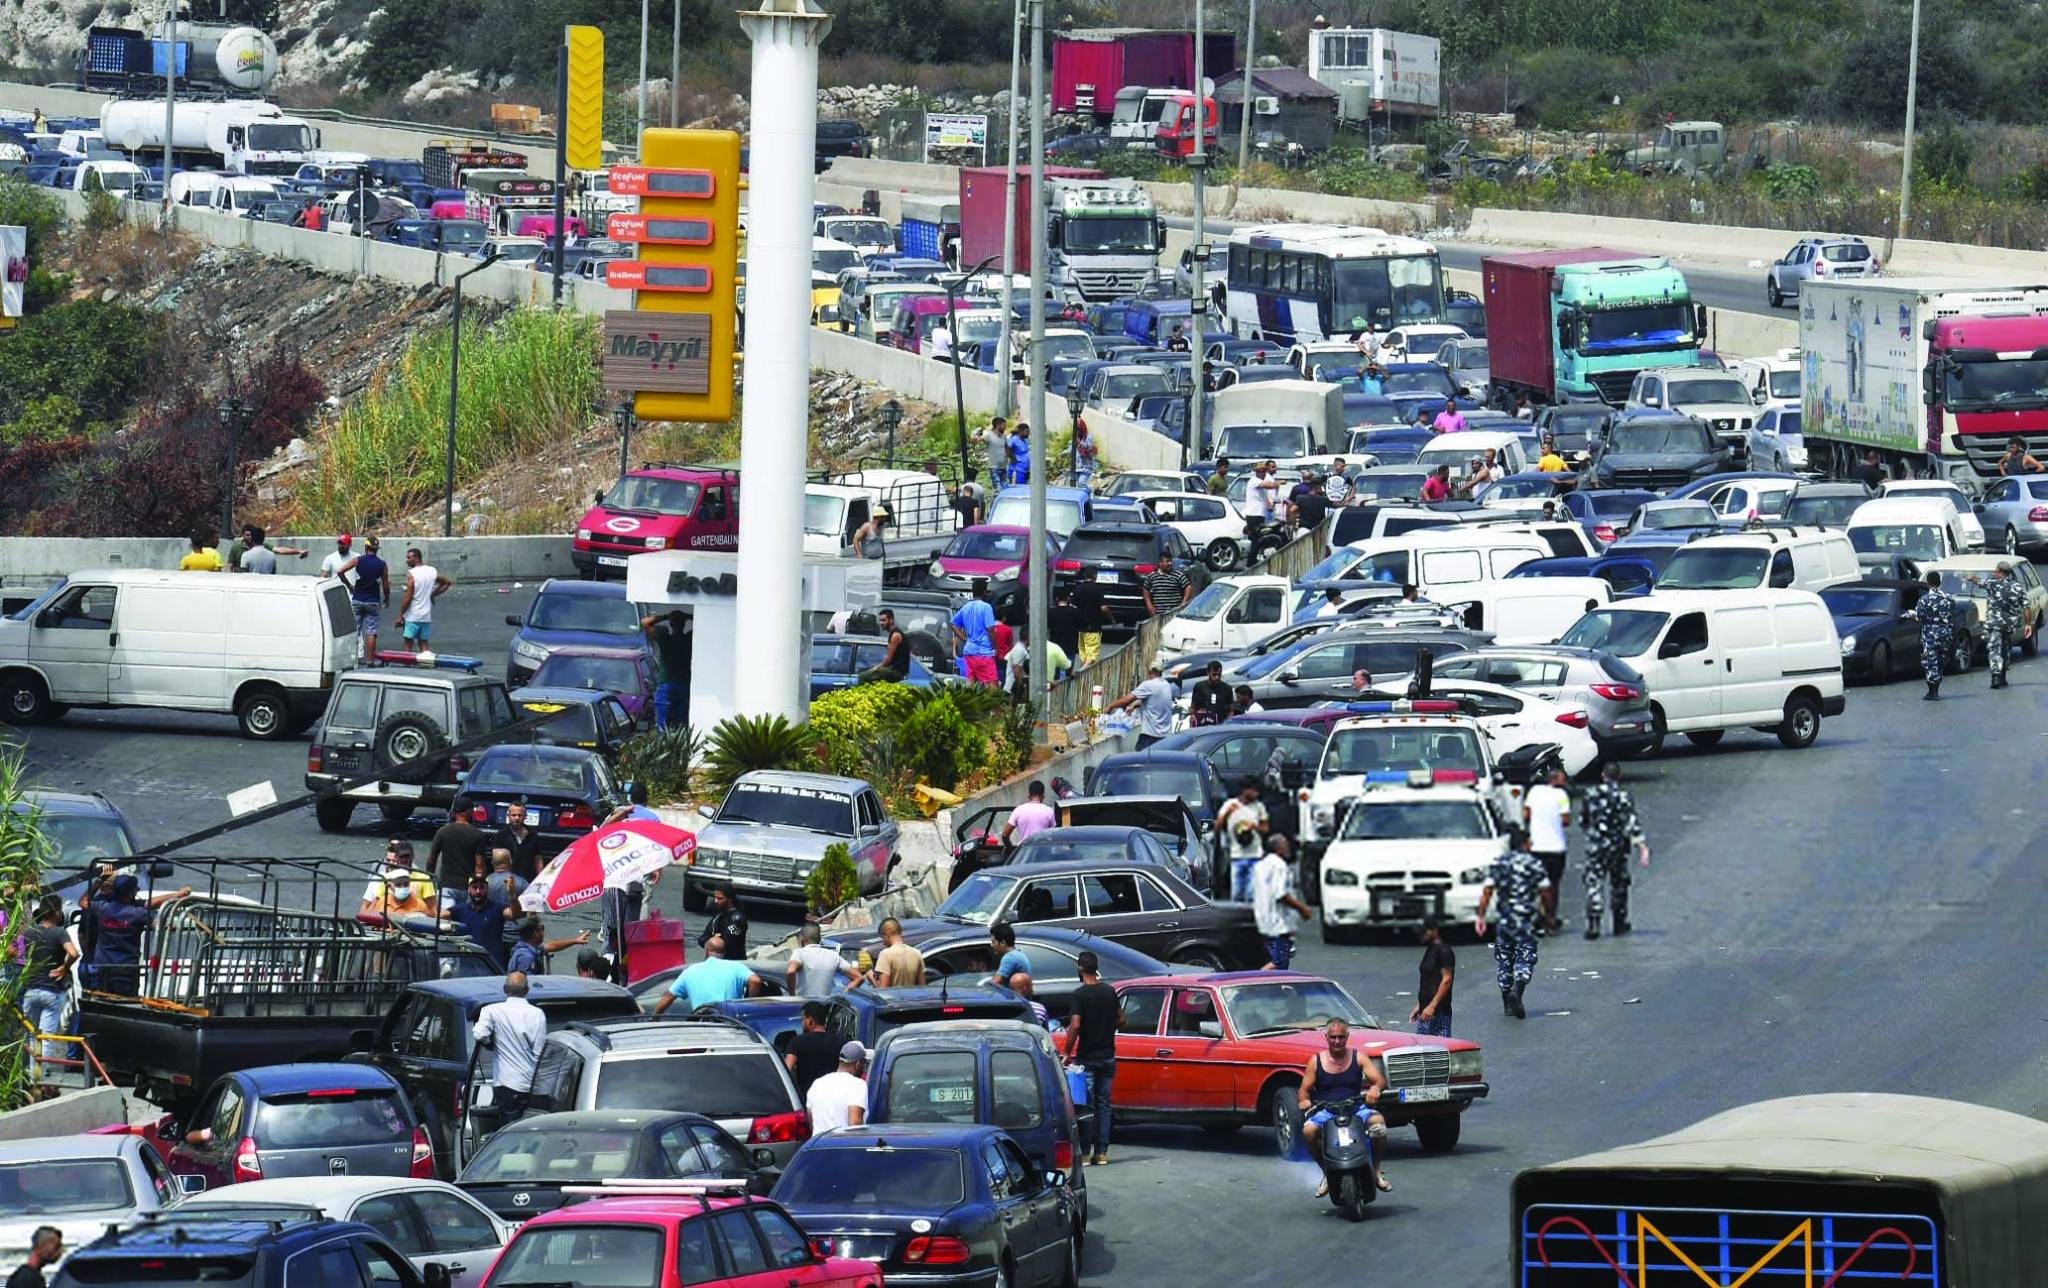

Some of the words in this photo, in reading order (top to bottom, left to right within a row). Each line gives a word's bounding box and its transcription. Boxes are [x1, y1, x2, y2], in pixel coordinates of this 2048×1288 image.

[1598, 300, 1644, 310] Mercedes
[1648, 297, 1674, 306] Benz
[556, 884, 600, 907] almaza
[938, 1089, 945, 1101] S
